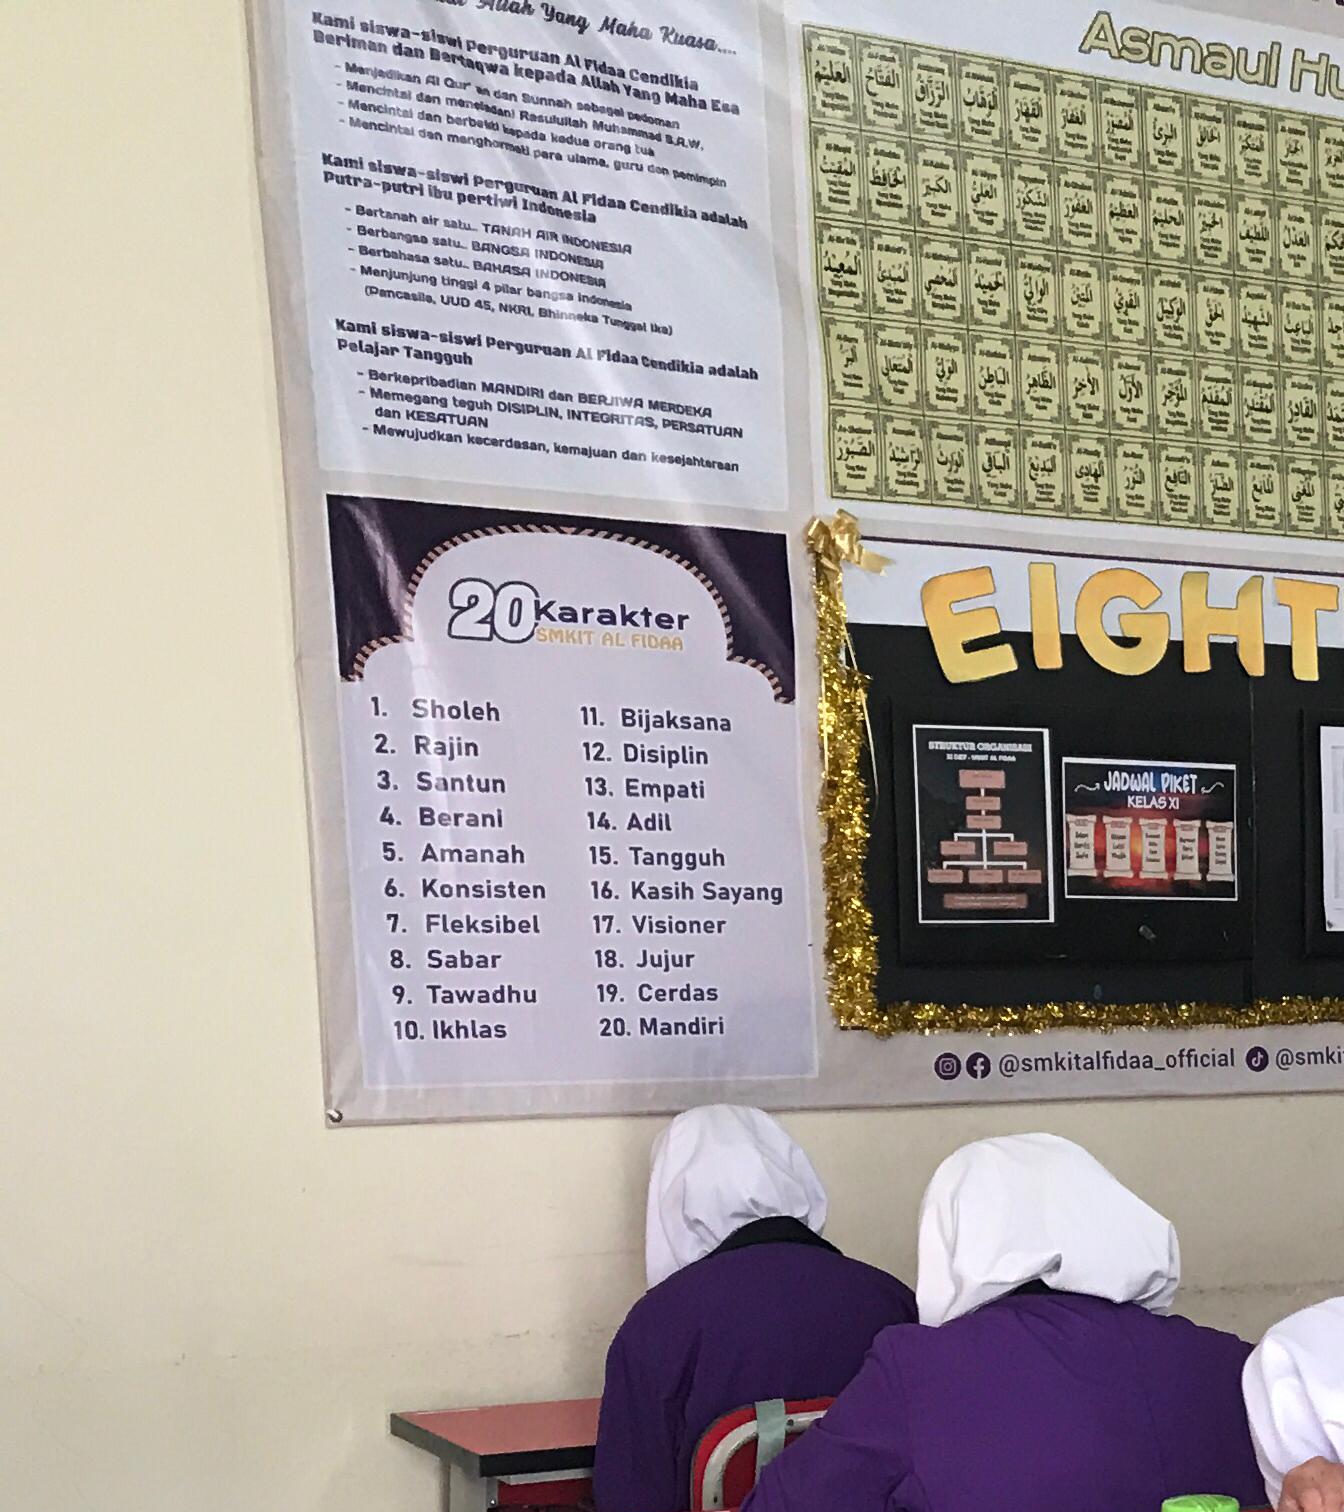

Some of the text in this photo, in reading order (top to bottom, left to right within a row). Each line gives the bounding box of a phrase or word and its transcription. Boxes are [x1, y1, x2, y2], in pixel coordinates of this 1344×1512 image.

[541, 2, 590, 35] Yang
[598, 15, 653, 40] Maha
[311, 12, 355, 30] Kami
[359, 20, 462, 49] siswa-siswi
[465, 40, 560, 64] Perguruan
[583, 58, 625, 79] Fidaa
[628, 69, 698, 91] Cendikia
[1079, 10, 1282, 87] Asmaul
[312, 30, 739, 115] Beriman dan Bertaqwa kepada Allah Yang Maha Esa
[321, 153, 364, 170] Kami
[367, 160, 469, 185] siswa-siswi
[472, 175, 558, 200] Perguruan
[581, 193, 626, 210] Fidaa
[629, 200, 697, 219] Cendikia
[700, 211, 748, 229] adalah
[322, 171, 596, 223] Putra-putri ibu pertiwi Indonesia
[355, 205, 417, 223] Bertanah
[421, 215, 439, 226] air
[481, 223, 531, 238] TANAH
[535, 230, 558, 242] AIR
[561, 234, 632, 254] INDONESIA
[356, 225, 428, 244] Berbangsa
[471, 241, 530, 257] BANGSA
[534, 249, 604, 269] INDONESIA
[335, 318, 376, 335] Kami
[381, 324, 482, 346] siswa-siswi
[485, 336, 571, 358] Perguruan
[596, 349, 638, 365] Fidaa
[640, 356, 704, 374] Cendikia
[708, 364, 758, 380] adalah
[336, 338, 472, 365] Pelajar Tangguh
[367, 369, 712, 418] Berkepribadian MANDIRI dan BERJIWA MERDEKA
[369, 387, 448, 408] Memegang
[451, 396, 492, 412] teguh
[661, 419, 743, 438] PERSATUAN
[375, 406, 488, 428] dan KESATUAN
[372, 424, 462, 443] Mewujudkan
[553, 442, 617, 459] kemajuan
[621, 450, 646, 461] dan
[651, 452, 739, 471] kesejahteraan
[448, 577, 689, 643] 20 Karakter
[536, 628, 684, 650] SMKIT AL FIDAA
[371, 696, 500, 721] 1. Sholeh
[581, 706, 731, 733] 11. Bijaksana
[374, 734, 478, 761] 2. Rajin
[583, 742, 708, 768] 12. Disiplin
[377, 770, 505, 793] 3. Santun
[585, 777, 704, 803] 13. Empati
[1104, 770, 1198, 794] JADWAL PIKET
[1127, 795, 1179, 810] KELAS XI
[380, 806, 502, 827] 4. Berani
[588, 812, 671, 831] 14. Adil
[383, 842, 524, 864] 5. Amanah
[590, 846, 725, 871] 15. Tangguh
[385, 878, 545, 899] 6. Konsisten
[591, 881, 782, 905] 16. Kasih Sayang
[387, 914, 540, 933] 7. Fleksibel
[593, 915, 726, 934] 17. Visioner
[391, 949, 501, 968] 8. Sabar
[595, 949, 695, 972] 18. Jujur
[392, 985, 537, 1004] 9. Tawadhu
[597, 983, 718, 1002] 19. Cerdas
[394, 1020, 507, 1040] 10. Ikhlas
[600, 1017, 724, 1036] 20. Mandiri
[999, 1048, 1235, 1077] @smkitalfidaa_official
